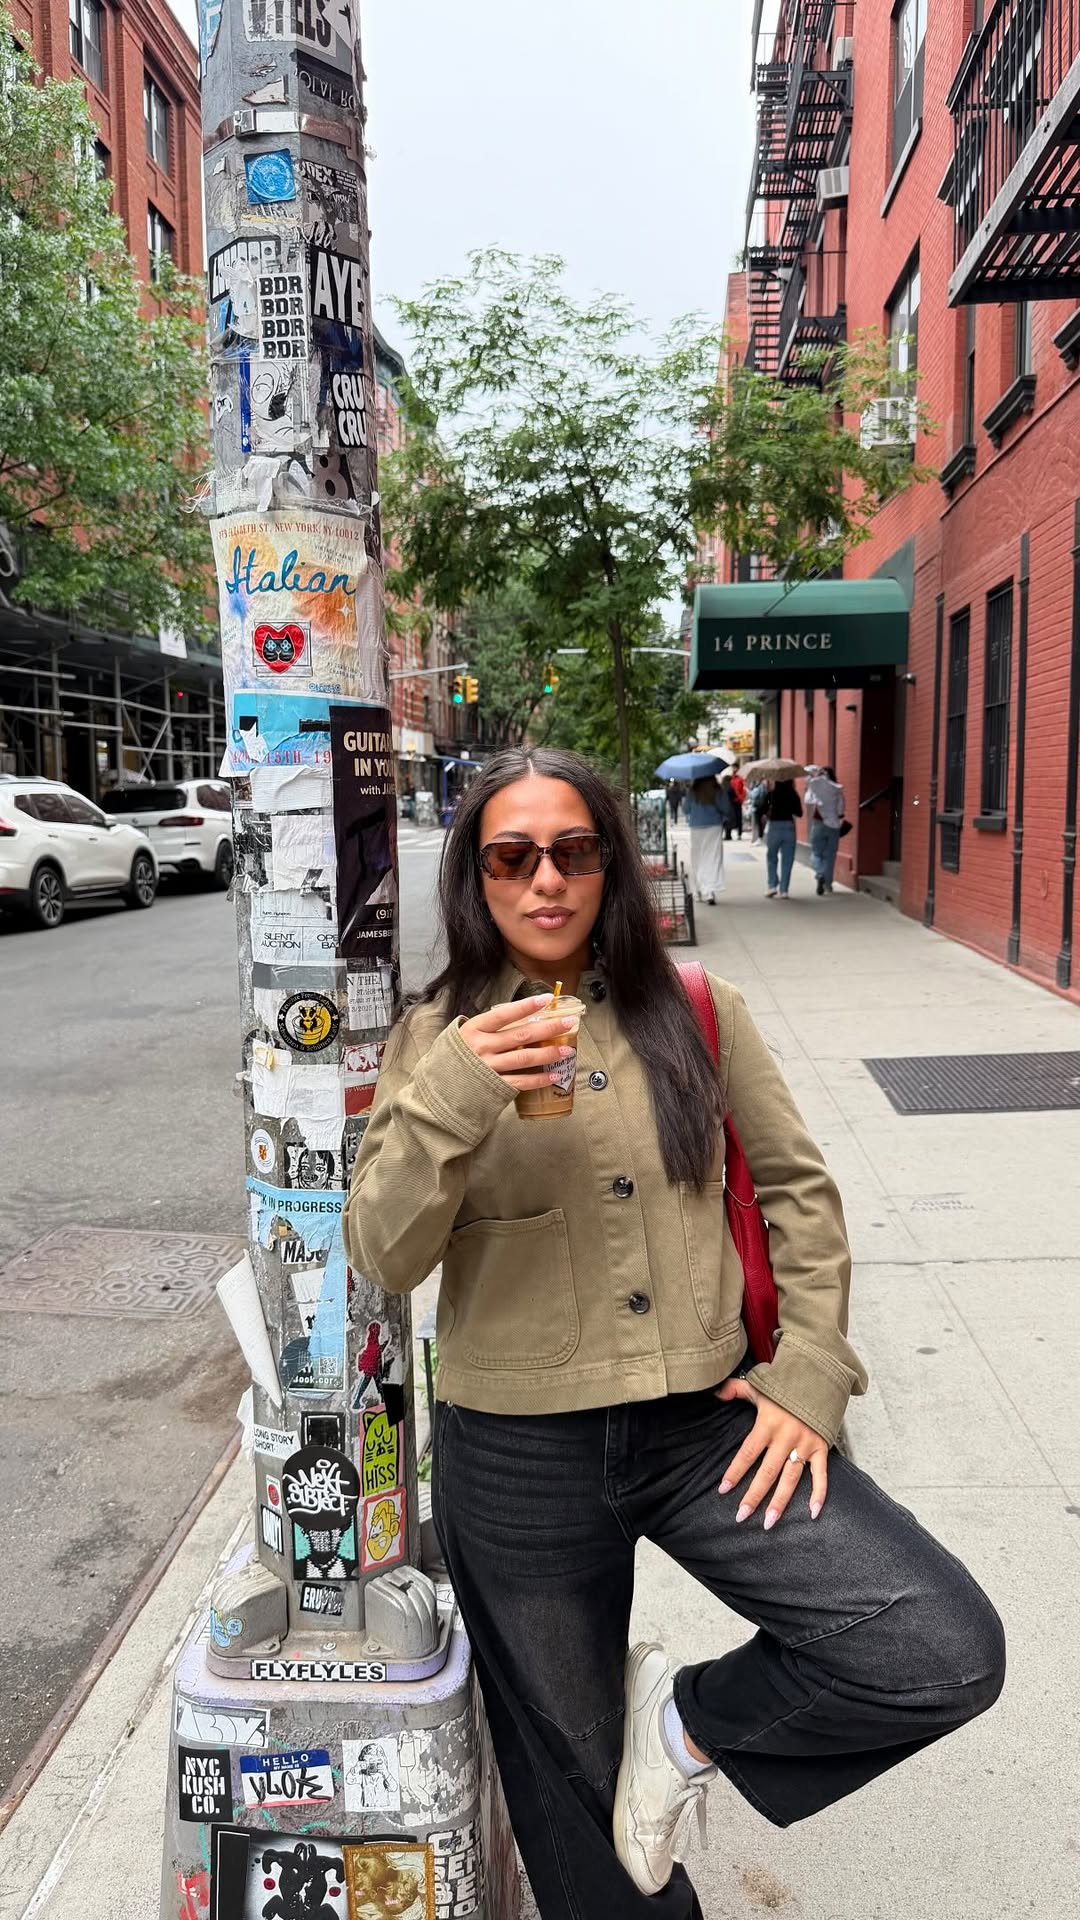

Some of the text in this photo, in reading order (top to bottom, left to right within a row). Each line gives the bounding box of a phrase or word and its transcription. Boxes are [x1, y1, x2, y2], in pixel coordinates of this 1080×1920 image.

[259, 276, 303, 296] BDR
[260, 297, 304, 317] BDR
[261, 318, 305, 338] BDR
[262, 340, 306, 359] BDR
[274, 522, 293, 532] NEW
[323, 525, 333, 536] NY
[225, 545, 356, 596] Italian
[714, 632, 833, 652] 14 PRINCE
[354, 757, 372, 777] IN
[360, 785, 381, 795] with
[260, 940, 338, 950] AUCTION BA
[263, 932, 295, 941] SILENT
[268, 1196, 276, 1210] IN
[277, 1200, 343, 1214] PROGRESS
[253, 1426, 295, 1445] LONG STORY
[254, 1438, 274, 1452] SHORT
[255, 1662, 384, 1680] FLYFLYLES
[184, 1756, 221, 1777] NYC
[262, 1753, 309, 1767] HELLO
[182, 1774, 226, 1796] KUSH
[191, 1796, 221, 1815] CO.
